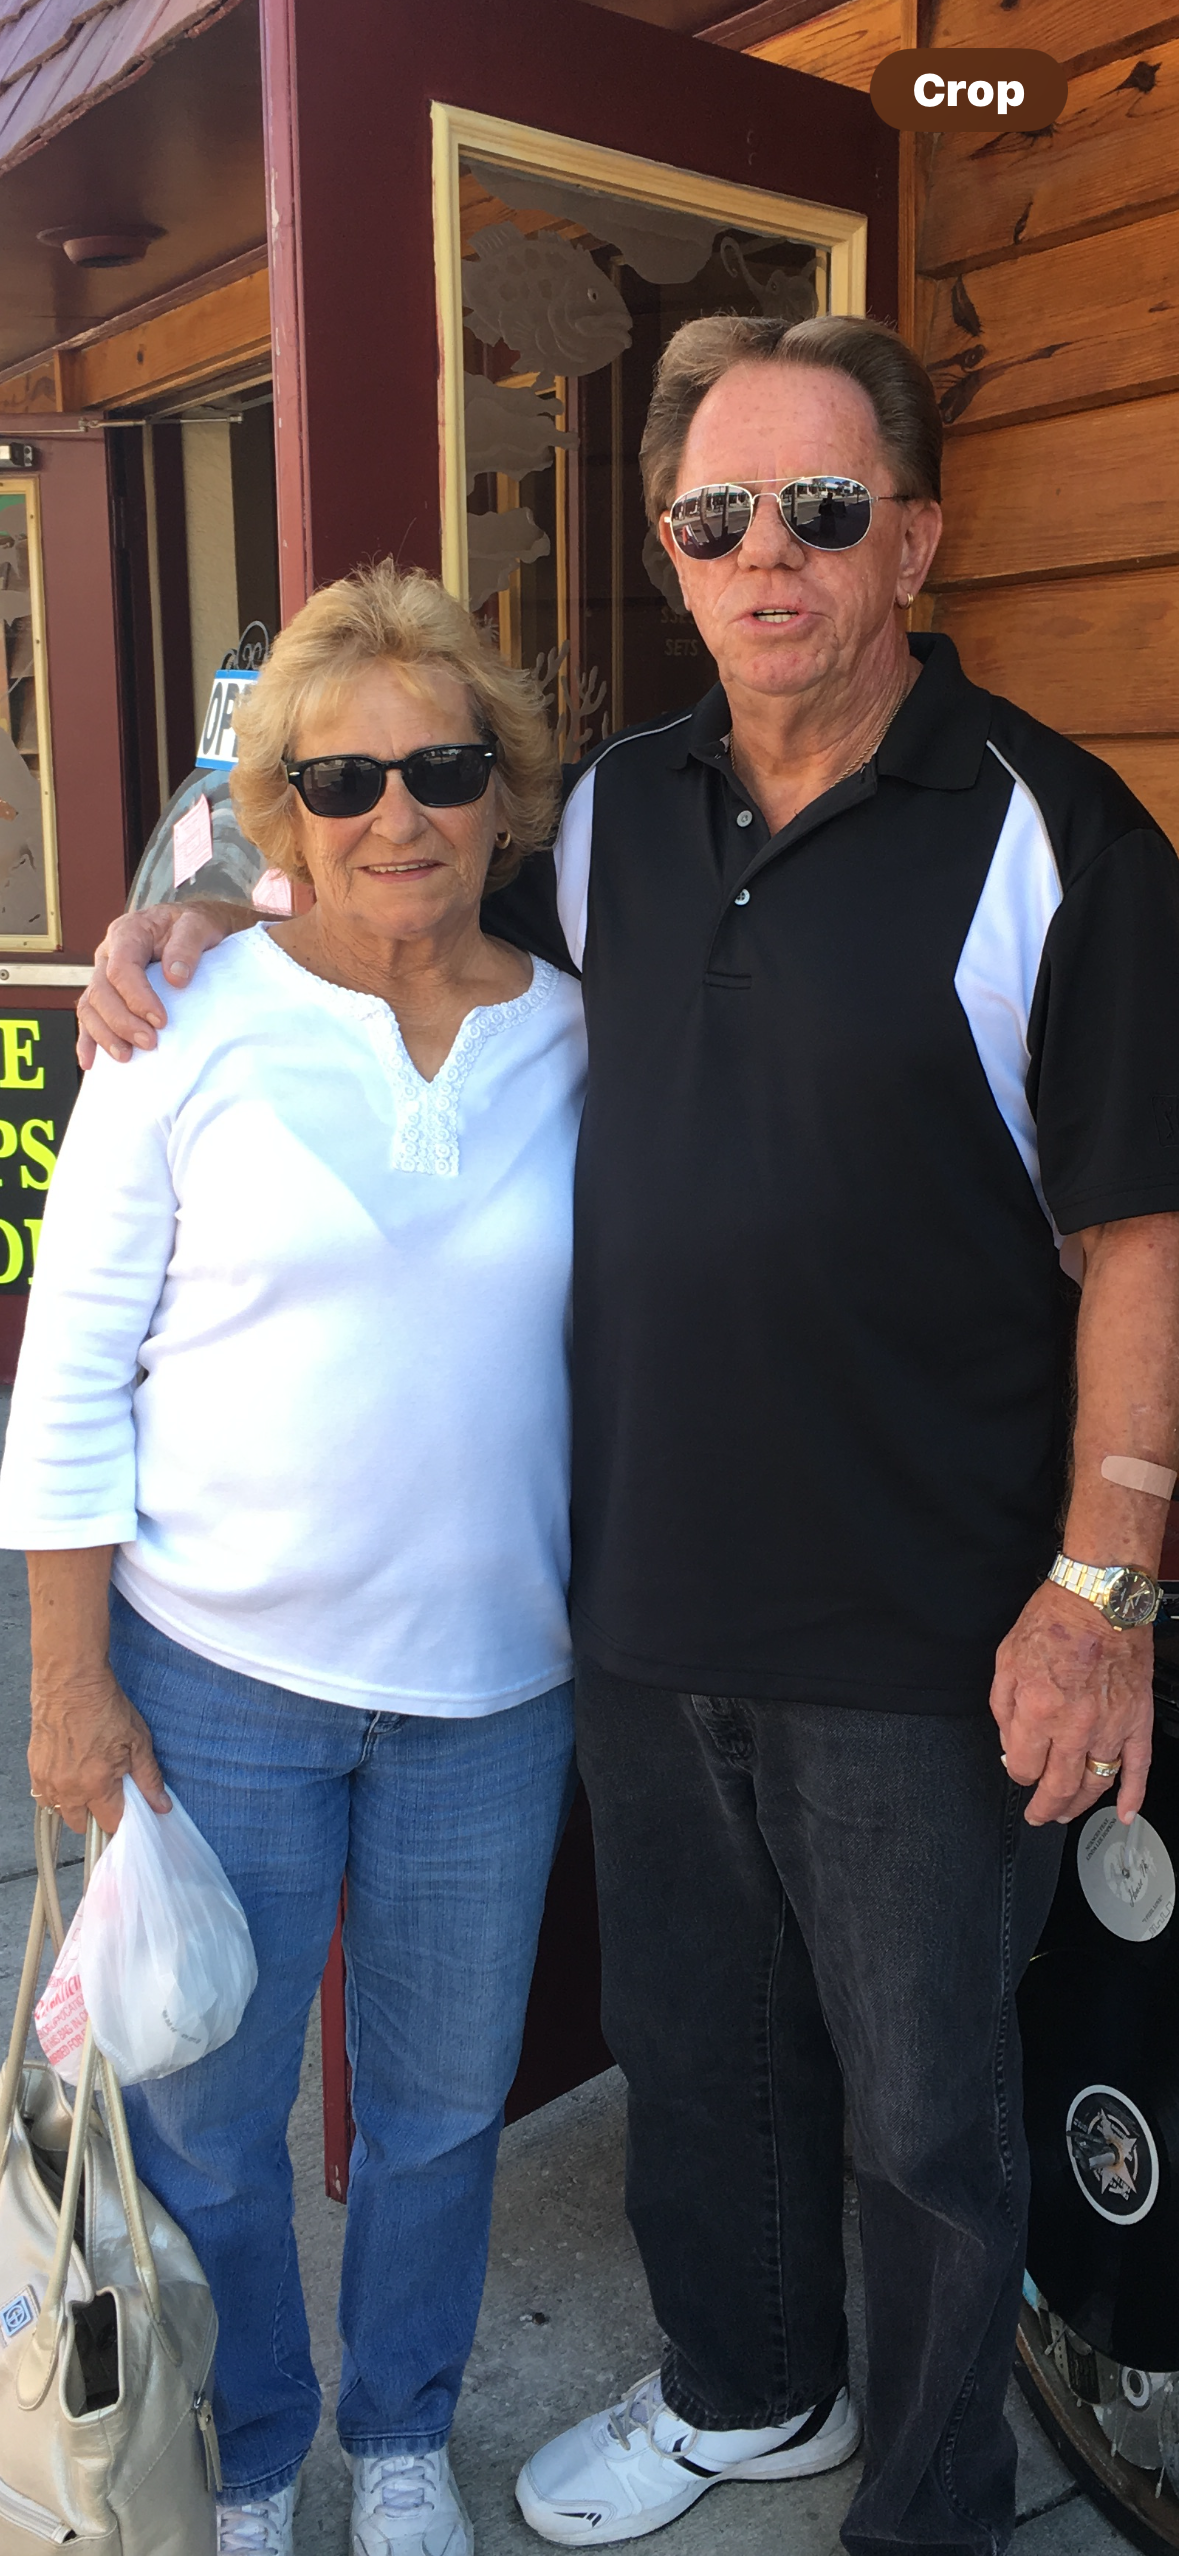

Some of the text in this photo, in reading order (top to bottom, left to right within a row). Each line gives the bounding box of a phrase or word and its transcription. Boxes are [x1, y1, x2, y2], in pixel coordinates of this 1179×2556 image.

[664, 638, 698, 657] SETS
[57, 2024, 73, 2040] BAG
[67, 2034, 83, 2051] FOR
